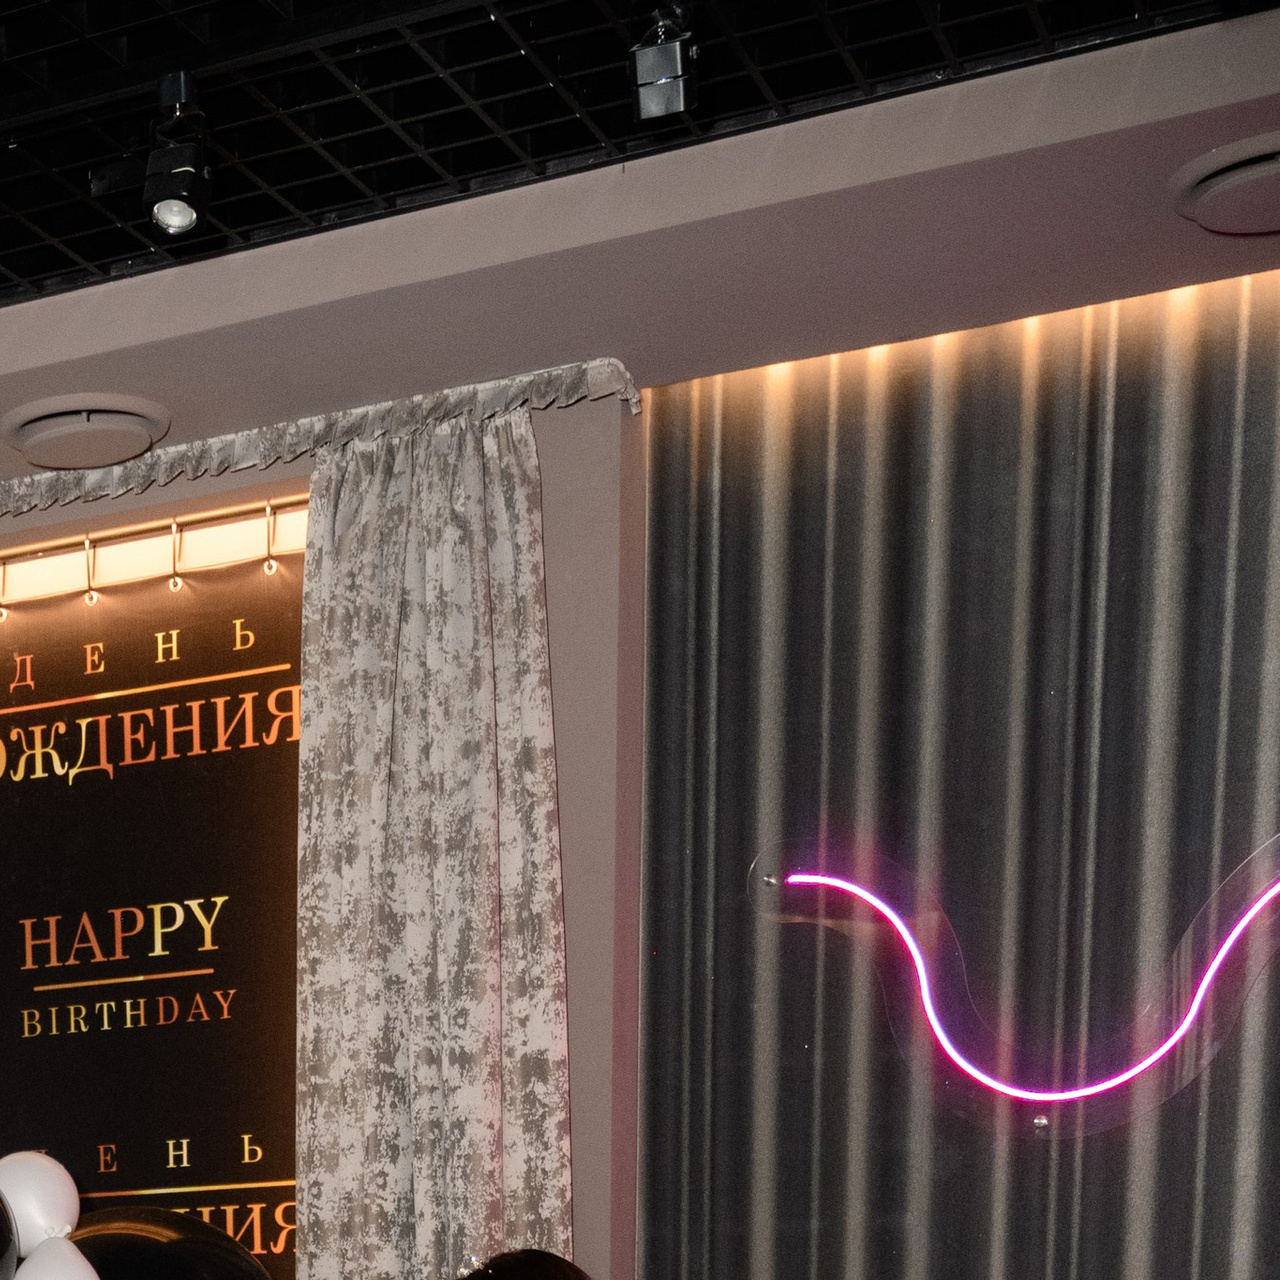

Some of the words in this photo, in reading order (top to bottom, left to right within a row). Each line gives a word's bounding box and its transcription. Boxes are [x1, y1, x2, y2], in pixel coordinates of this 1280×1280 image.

[10, 619, 255, 693] ДЕНЬ
[19, 896, 229, 970] HAPPY
[21, 989, 238, 1038] BIRTHDAY
[35, 1135, 263, 1173] ЕНЬ
